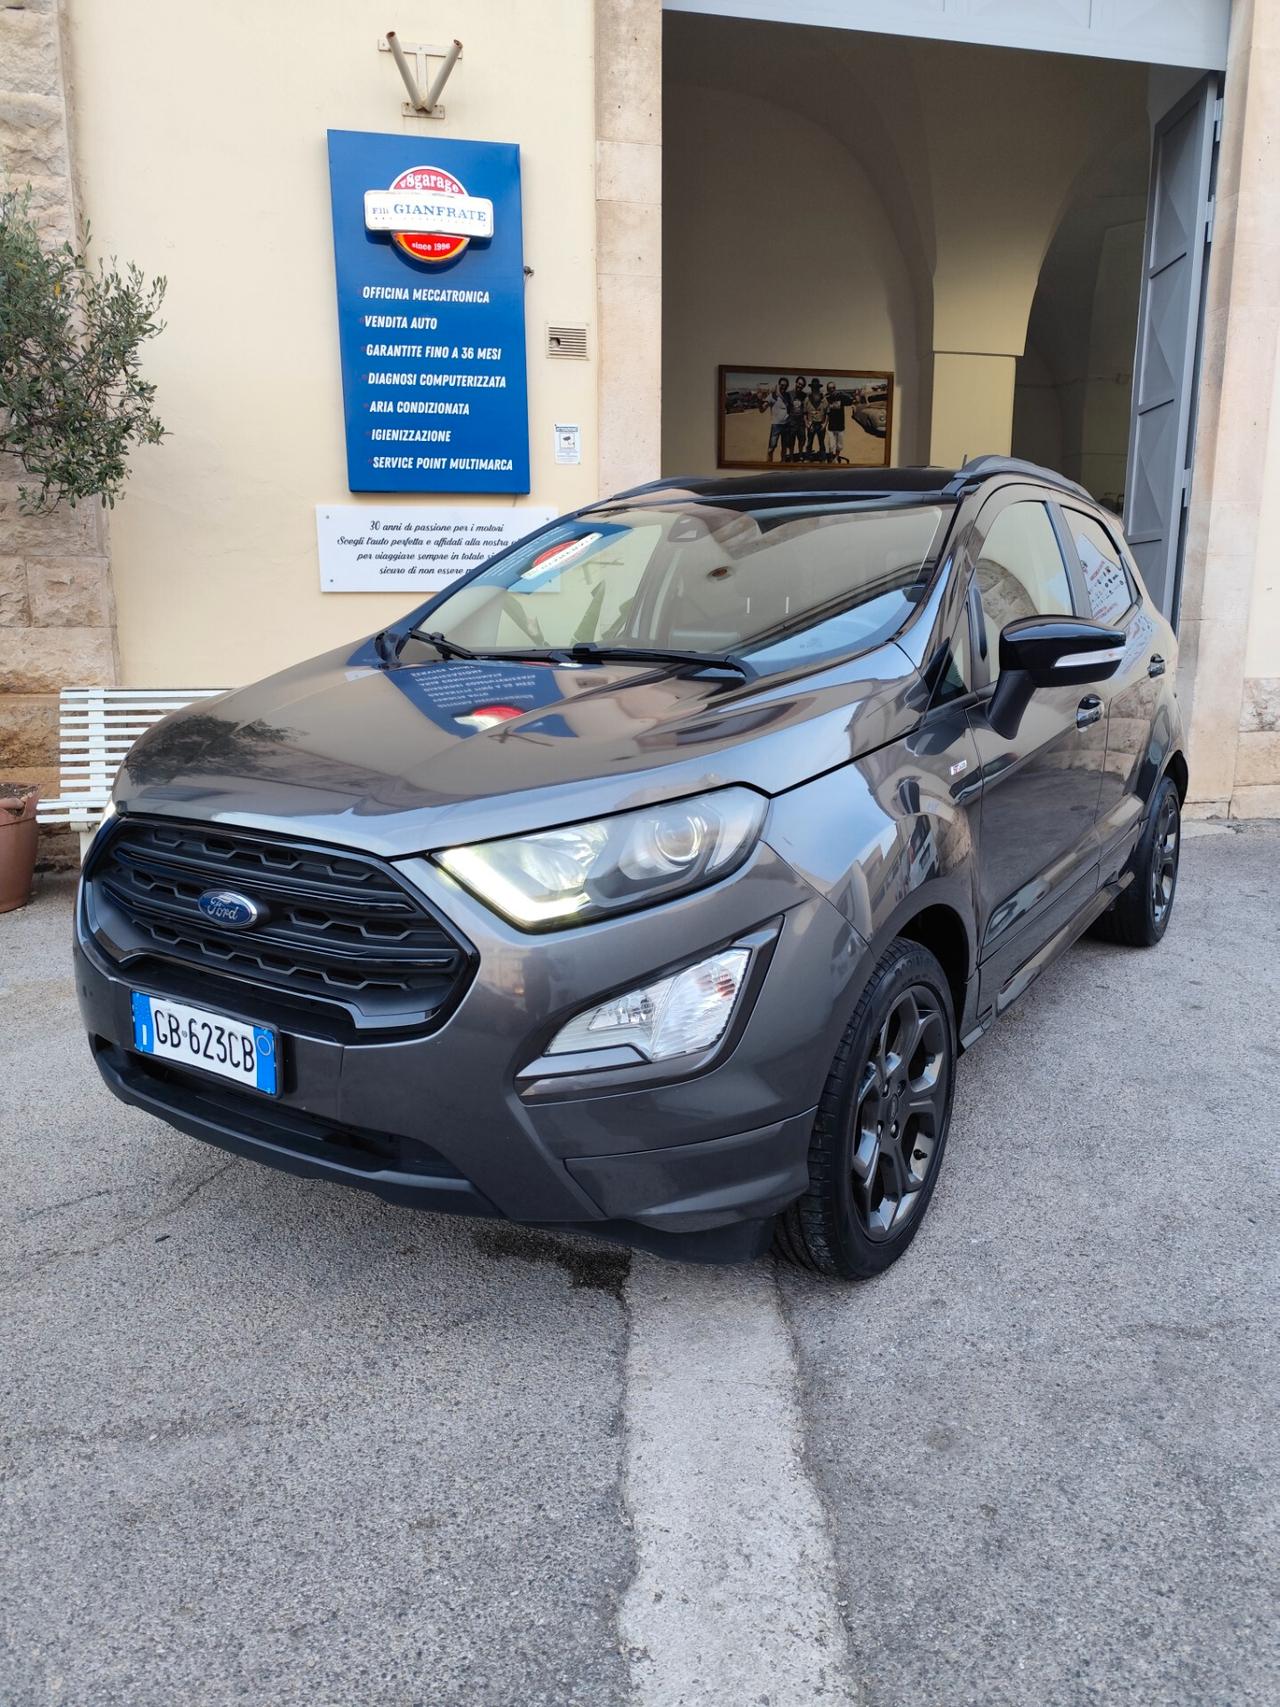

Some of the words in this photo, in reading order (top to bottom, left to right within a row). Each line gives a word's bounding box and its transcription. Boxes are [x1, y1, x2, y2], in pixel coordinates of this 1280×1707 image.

[393, 203, 487, 222] GIANFRATE
[412, 241, 432, 251] since
[363, 286, 410, 300] OFFICINA
[412, 288, 490, 303] MECCATRONICA
[364, 315, 408, 329] VENDITA
[410, 317, 438, 330] AUTO
[366, 344, 422, 358] GARANTITE
[425, 346, 449, 359] FINO
[451, 347, 459, 359] A
[461, 347, 474, 360] 36
[477, 347, 502, 360] MESI
[368, 373, 417, 386] DIAGNOSI
[419, 374, 507, 388] COMPUTERIZZATA
[369, 400, 394, 413] ARIA
[396, 401, 470, 416] CONDIZIONATA
[371, 429, 452, 442] IGIENIZZAZIONE
[372, 456, 414, 469] SERVICE
[416, 457, 447, 470] POINT
[449, 458, 513, 471] MULTIMARCA
[370, 521, 381, 532] 30
[382, 523, 402, 533] anni
[404, 523, 412, 533] di
[414, 523, 452, 534] passione
[453, 525, 468, 534] per
[470, 524, 475, 533] i
[476, 524, 504, 533] motori
[337, 536, 364, 548] Scegli
[366, 537, 389, 547] l'auto
[390, 537, 423, 548] perfetta
[433, 537, 463, 548] affidati
[464, 537, 481, 547] alla
[482, 538, 509, 547] nostra
[356, 552, 372, 562] per
[374, 551, 416, 562] viaggiare
[417, 552, 449, 562] sempre
[450, 551, 459, 561] in
[461, 551, 485, 561] totale
[379, 566, 405, 576] sicuro
[407, 565, 416, 576] di
[418, 567, 435, 576] non
[437, 567, 463, 576] essere
[207, 896, 240, 921] Ford
[188, 1017, 255, 1073] 623CB
